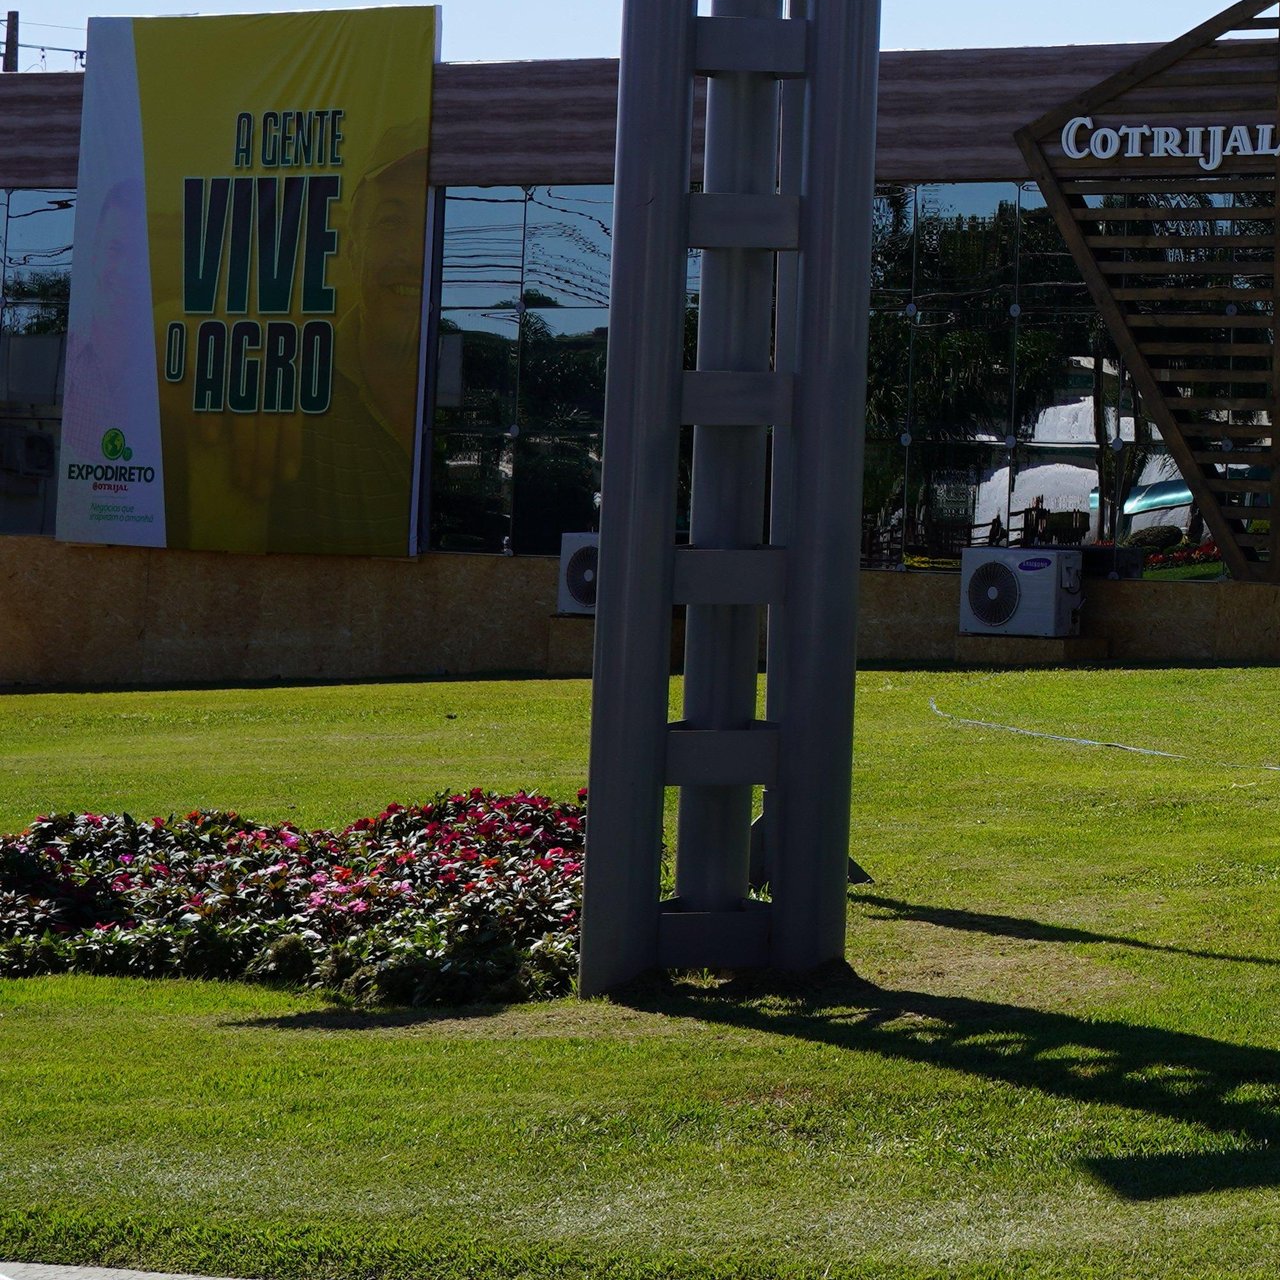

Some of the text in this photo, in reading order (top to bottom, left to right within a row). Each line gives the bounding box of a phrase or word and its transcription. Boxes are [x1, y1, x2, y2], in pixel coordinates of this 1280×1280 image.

[234, 110, 345, 168] A GENTE
[182, 174, 341, 316] VIVE
[165, 320, 335, 416] O AGRO
[67, 464, 155, 483] EXPODIRETO
[92, 482, 129, 493] COTRIJAL
